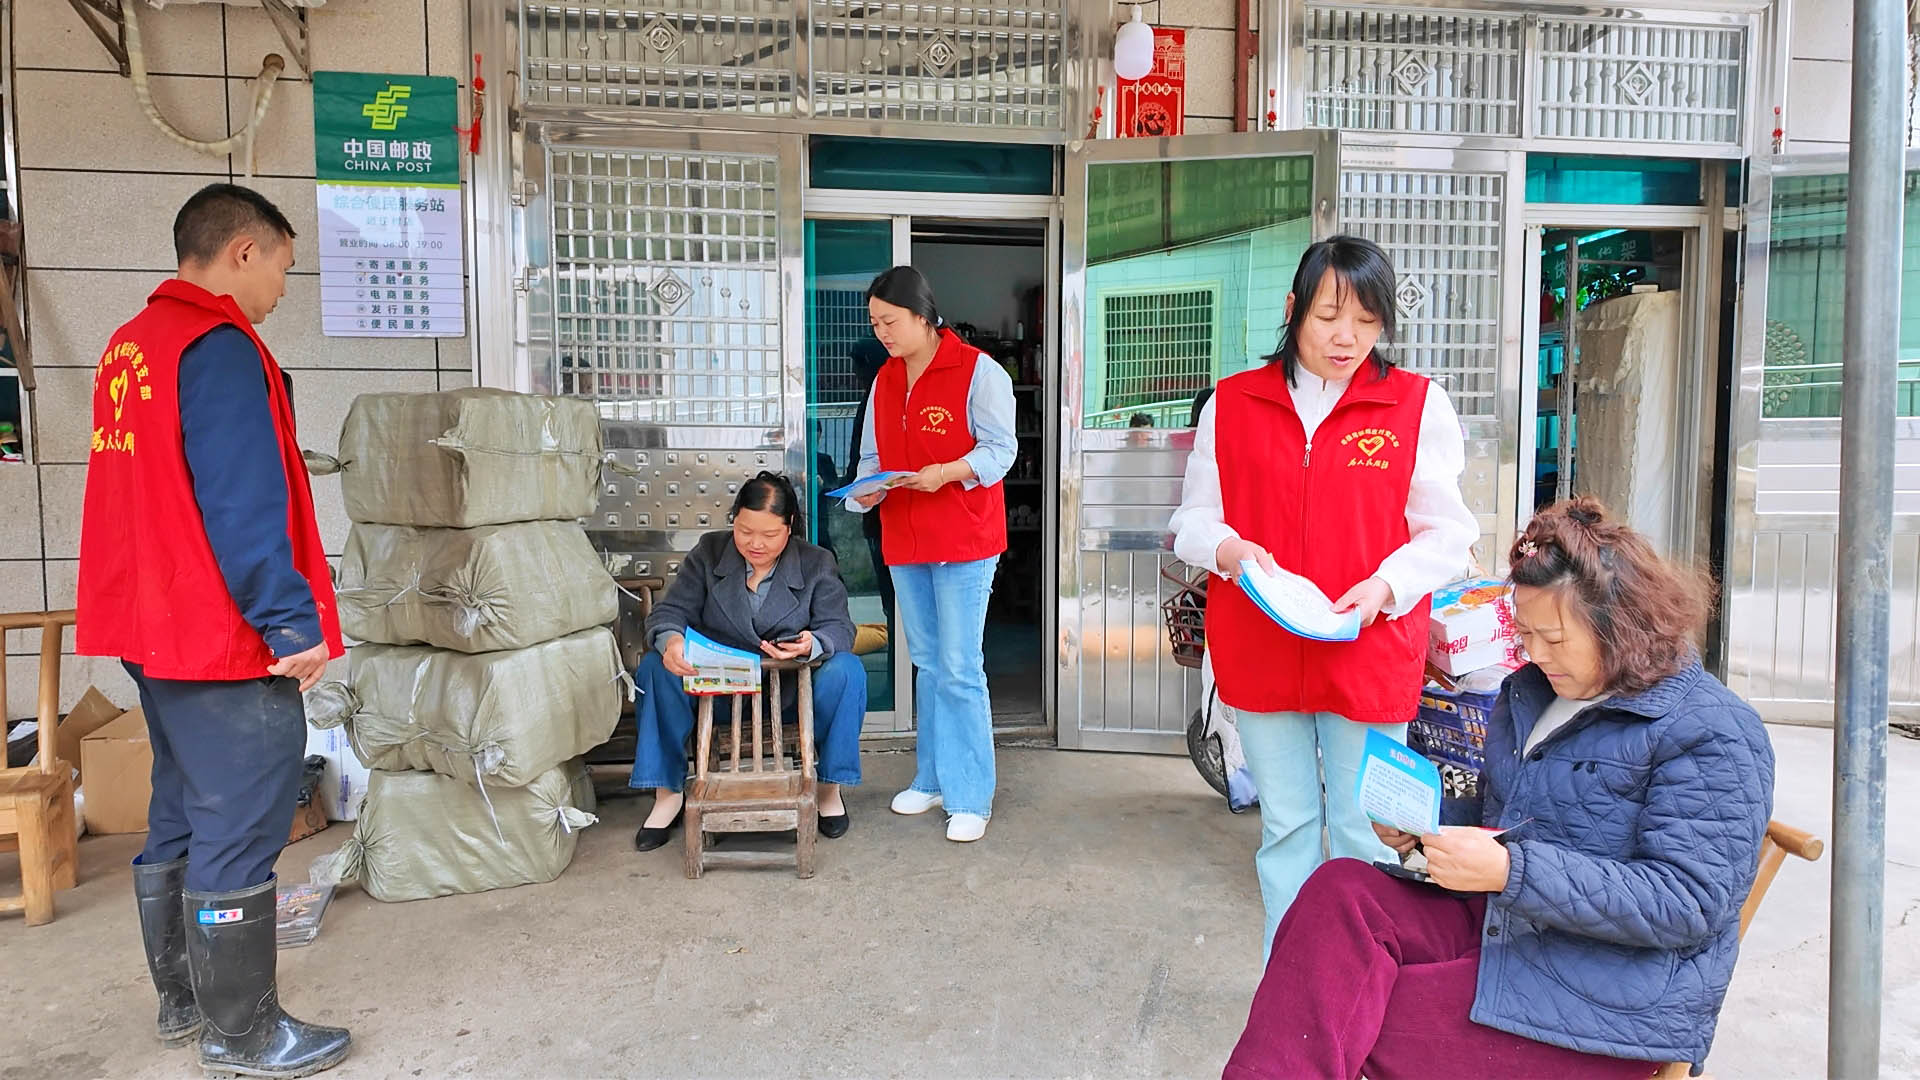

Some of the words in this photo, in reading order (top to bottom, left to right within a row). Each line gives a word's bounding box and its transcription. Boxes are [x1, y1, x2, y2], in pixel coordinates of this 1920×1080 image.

[343, 138, 432, 160] 中国邮政
[344, 160, 391, 171] CHINA
[396, 161, 432, 173] POST
[369, 260, 429, 271] 寄递服务
[369, 274, 429, 286] 金融服务
[370, 289, 430, 301] 电商服务
[371, 304, 430, 315] 发行服务
[371, 319, 431, 330] 便民服务
